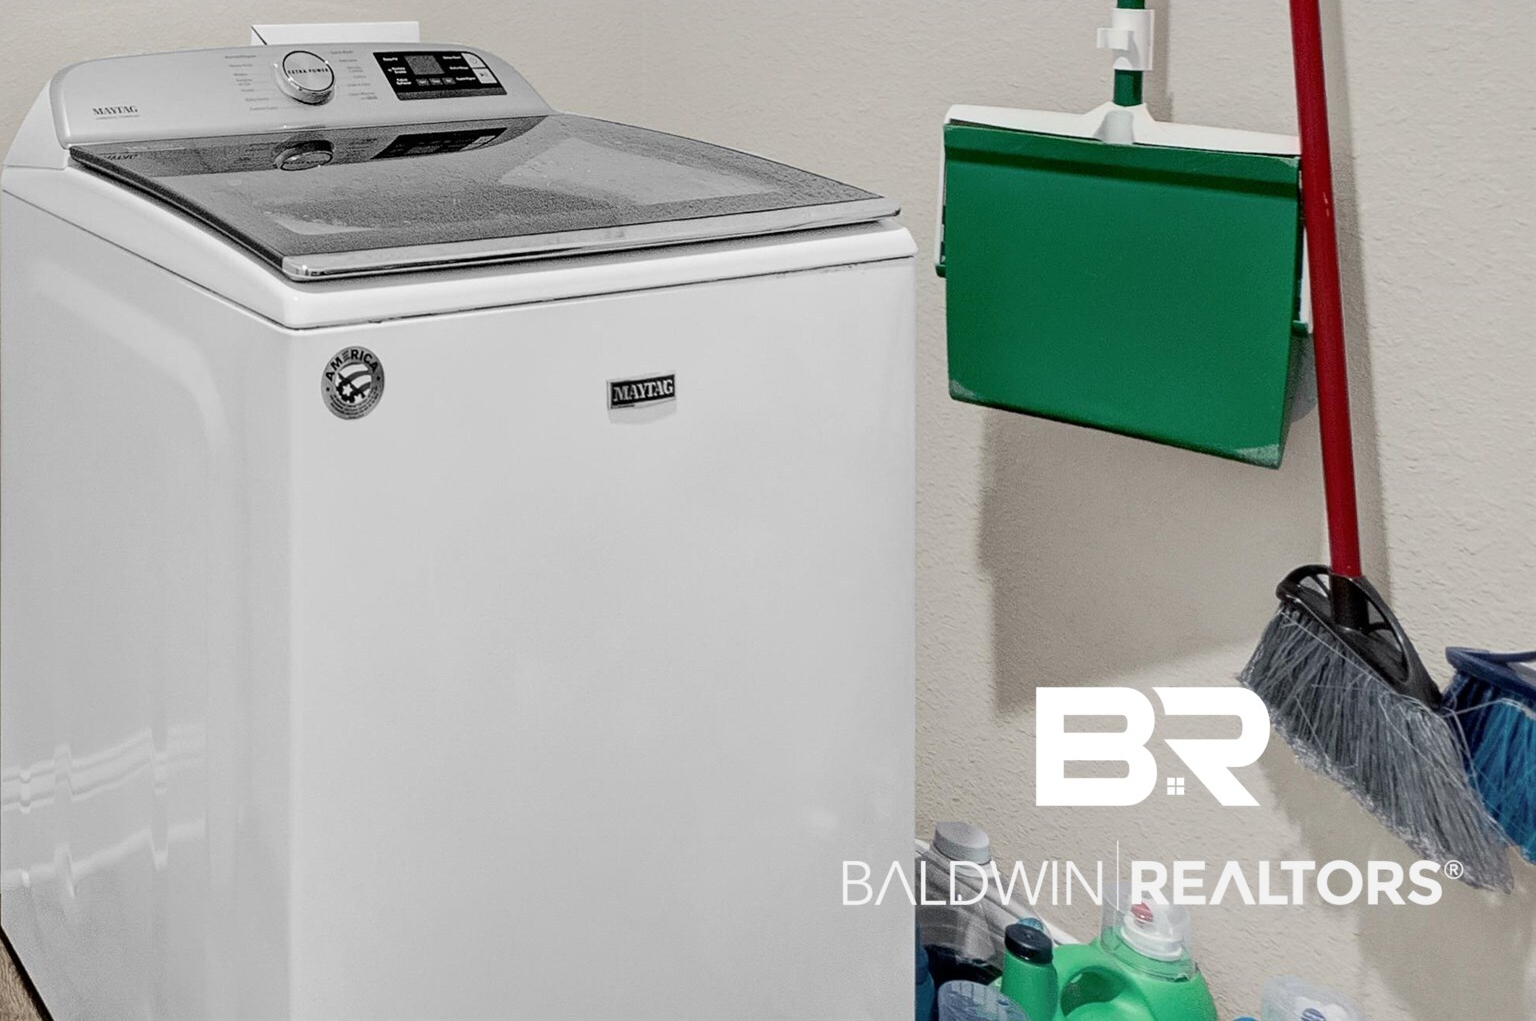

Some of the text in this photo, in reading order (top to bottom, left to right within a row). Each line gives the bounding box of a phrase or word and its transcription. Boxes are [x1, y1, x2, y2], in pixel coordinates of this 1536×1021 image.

[93, 105, 139, 115] MAYTAG
[325, 349, 378, 381] AMERICA
[613, 379, 673, 402] MAYTAG
